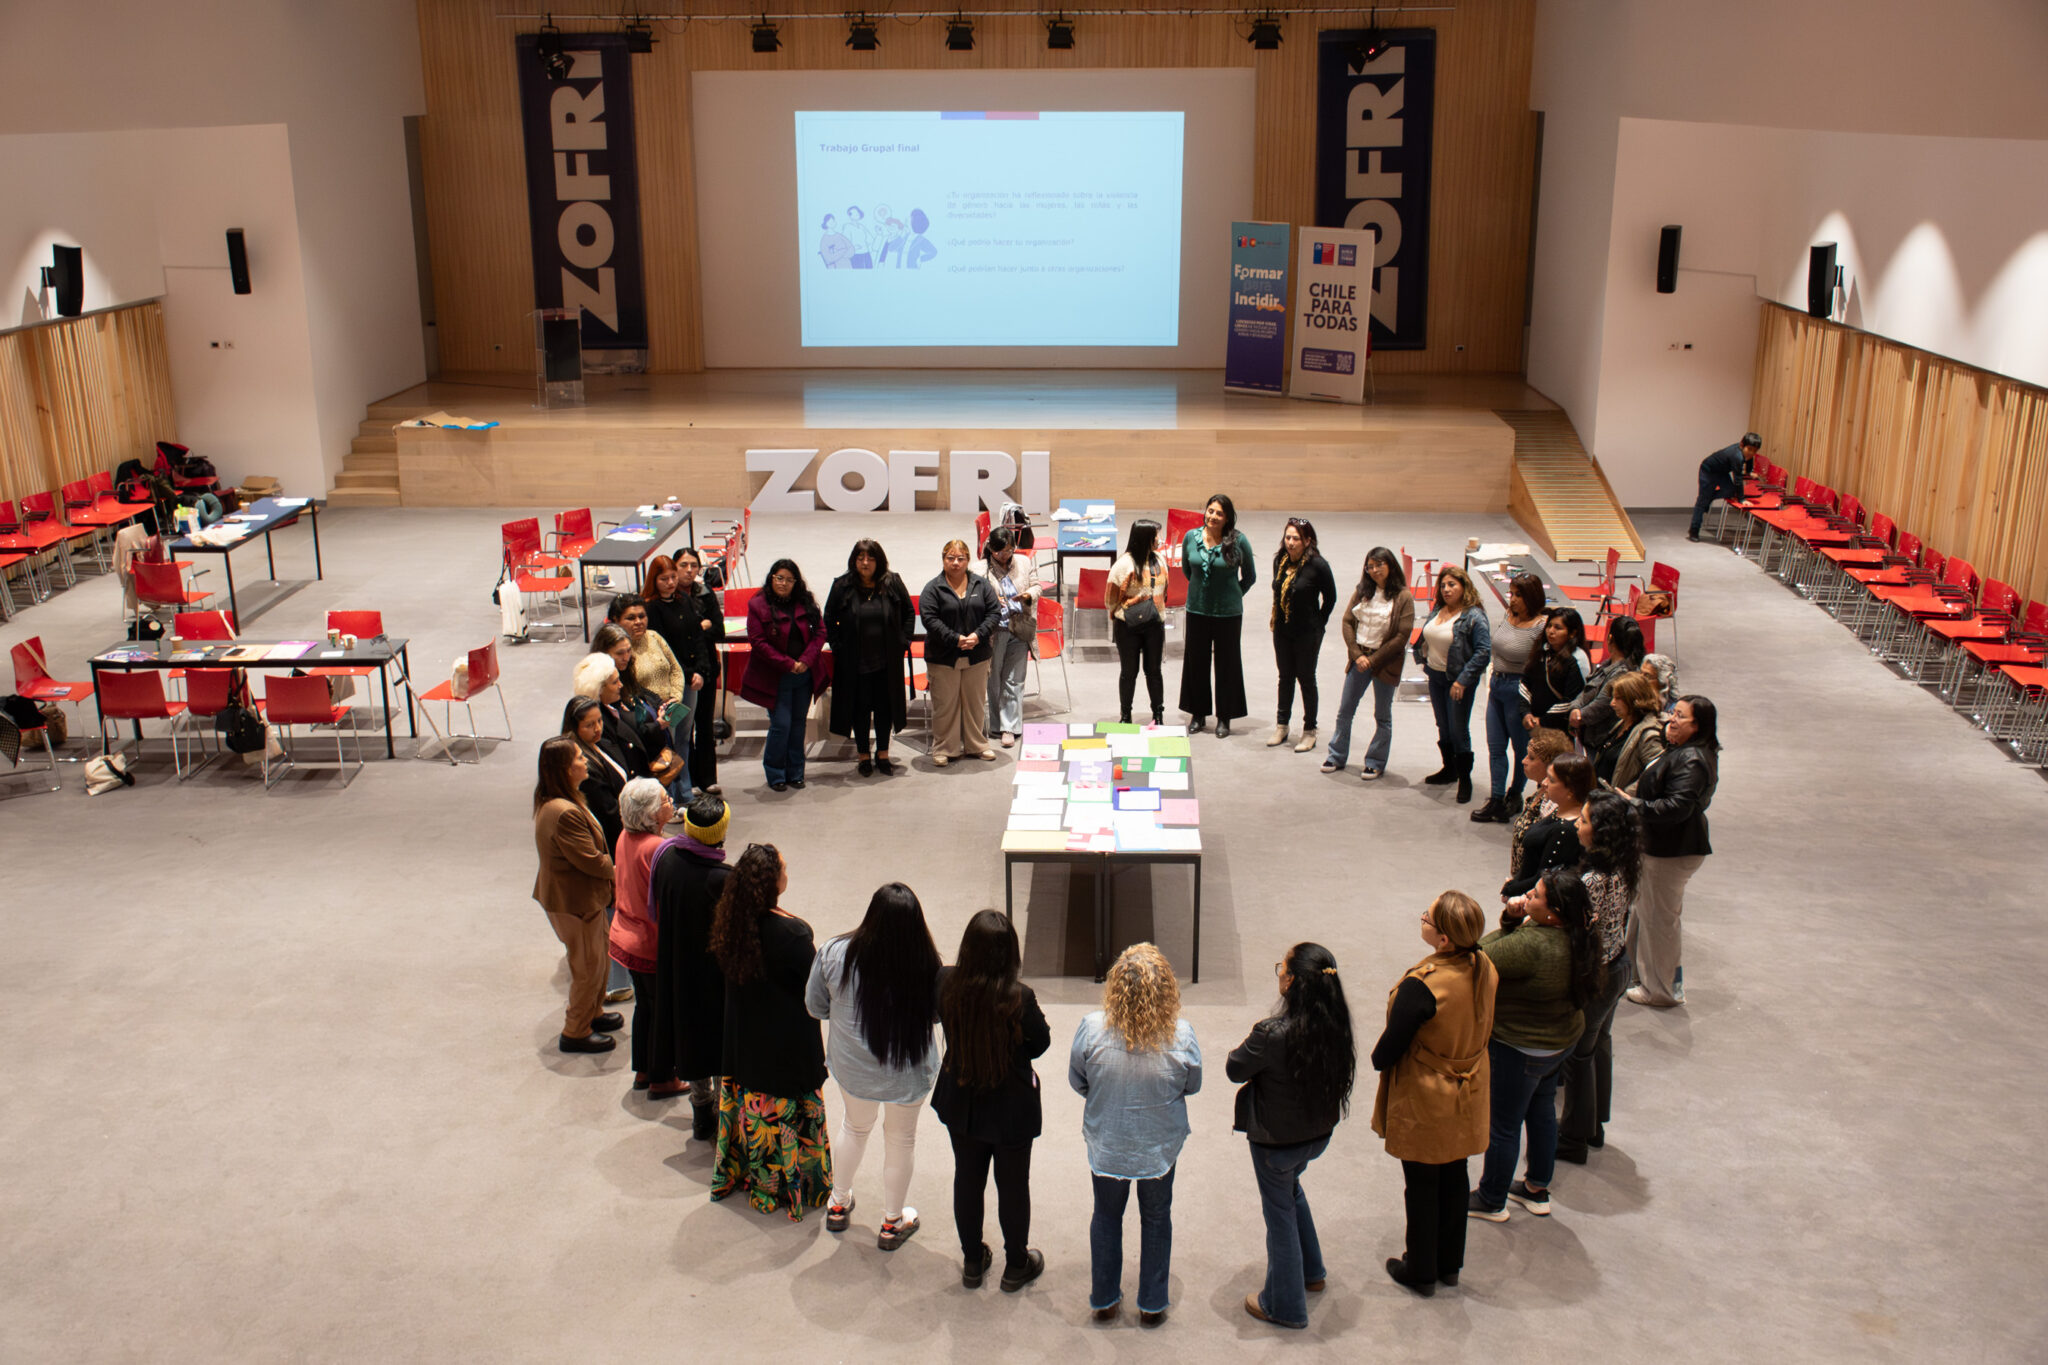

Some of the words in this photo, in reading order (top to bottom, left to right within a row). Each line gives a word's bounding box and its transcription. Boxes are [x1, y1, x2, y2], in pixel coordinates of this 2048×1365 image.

[820, 143, 858, 154] Trabajo
[861, 143, 895, 154] Grupal
[897, 143, 920, 152] final
[549, 50, 619, 333] ZOFRI
[1234, 263, 1284, 280] Formar
[1234, 291, 1280, 307] Incidir
[1309, 282, 1357, 300] CHILE
[1311, 298, 1353, 316] PARA
[1303, 312, 1358, 332] TODAS
[745, 447, 1051, 513] ZOFRI
